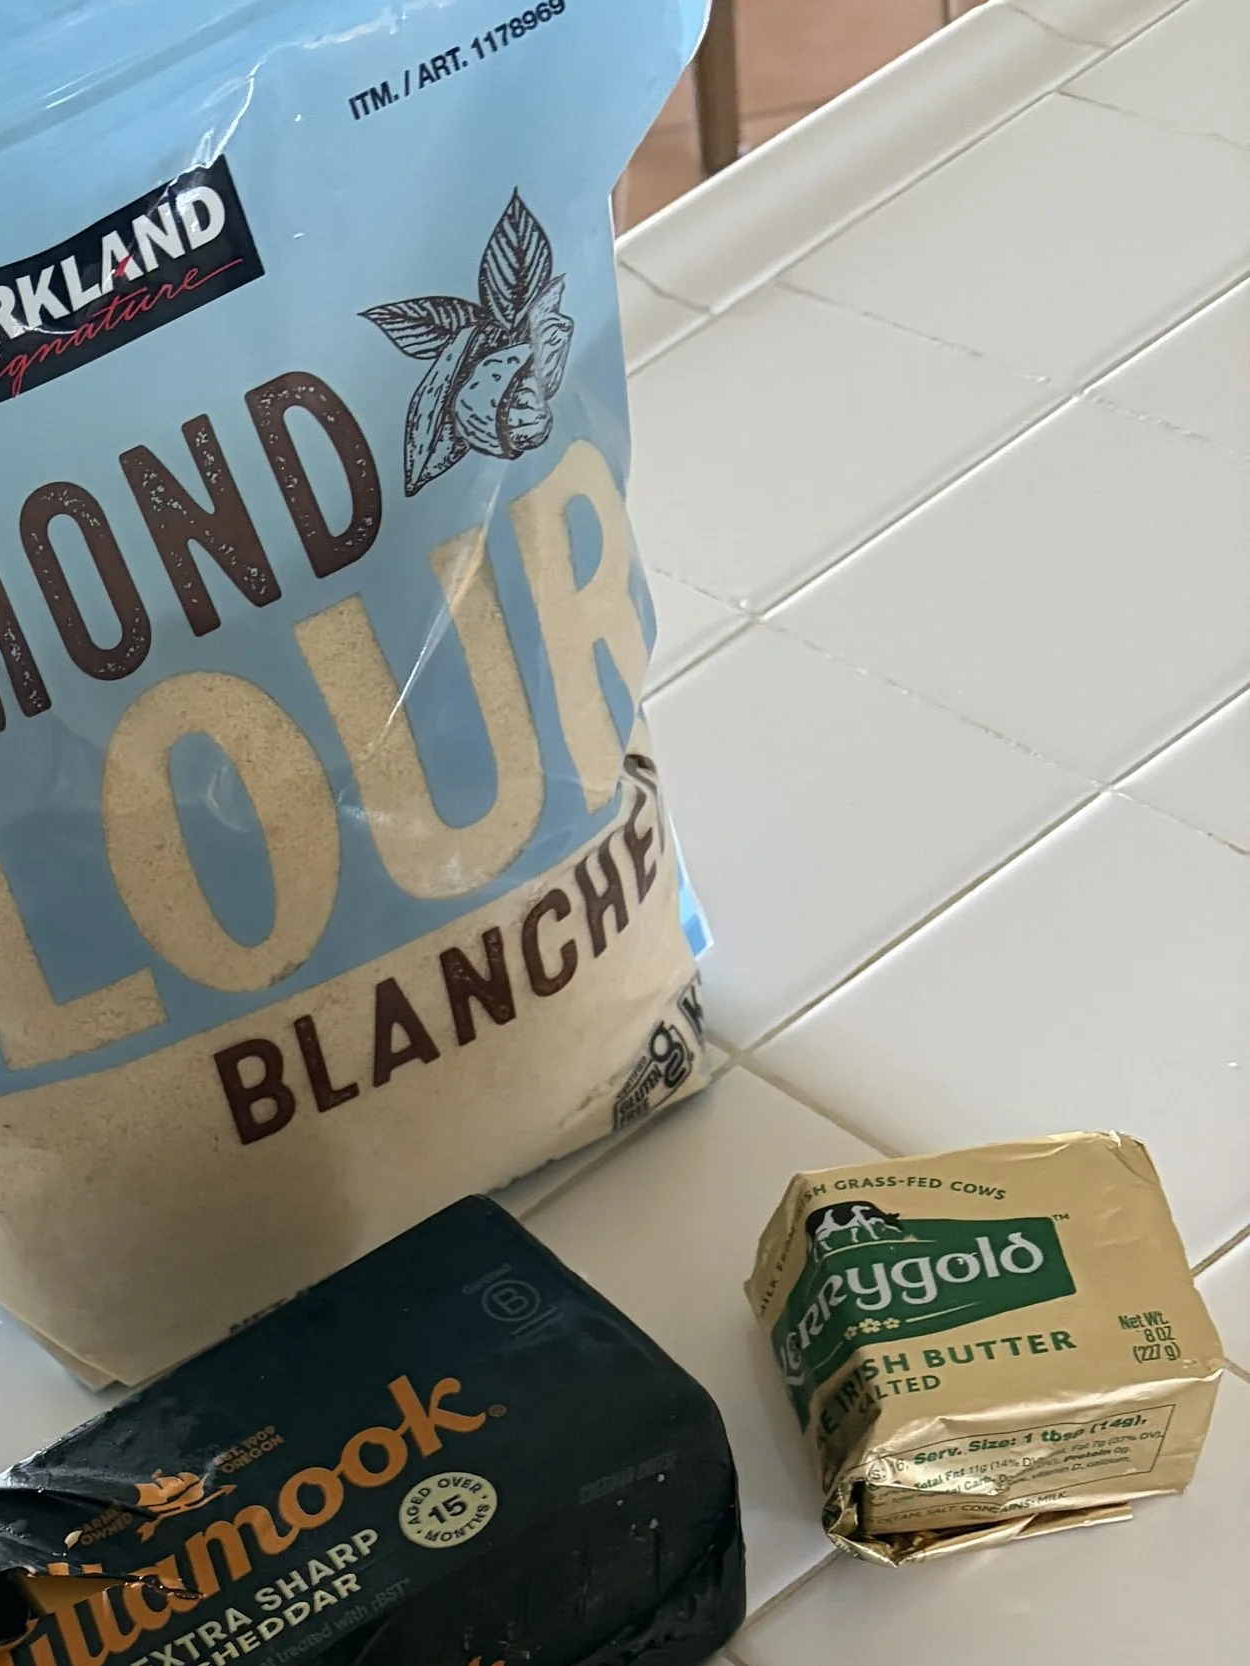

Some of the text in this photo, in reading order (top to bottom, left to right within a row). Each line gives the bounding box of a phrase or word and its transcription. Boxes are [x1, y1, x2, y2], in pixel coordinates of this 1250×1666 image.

[348, 0, 567, 120] ITM. / ART. 1178969
[833, 1175, 944, 1191] GRASS-FED
[950, 1180, 1008, 1201] COWS
[1117, 1313, 1145, 1331] Net
[1143, 1327, 1157, 1344] 8
[924, 1330, 1078, 1370] BUTTER
[1132, 1341, 1183, 1366] (227 g)
[859, 1374, 942, 1421] SALTED
[912, 1447, 964, 1466] Serv.
[968, 1437, 1018, 1453] Size:
[1022, 1433, 1033, 1444] 1
[1040, 1428, 1085, 1443] tbsp
[406, 1476, 484, 1526] AGED OVER
[428, 1493, 468, 1525] 15
[424, 1503, 493, 1543] MONTHS
[254, 1528, 379, 1612] SHARP
[276, 1621, 334, 1665] treated
[334, 1604, 369, 1632] with
